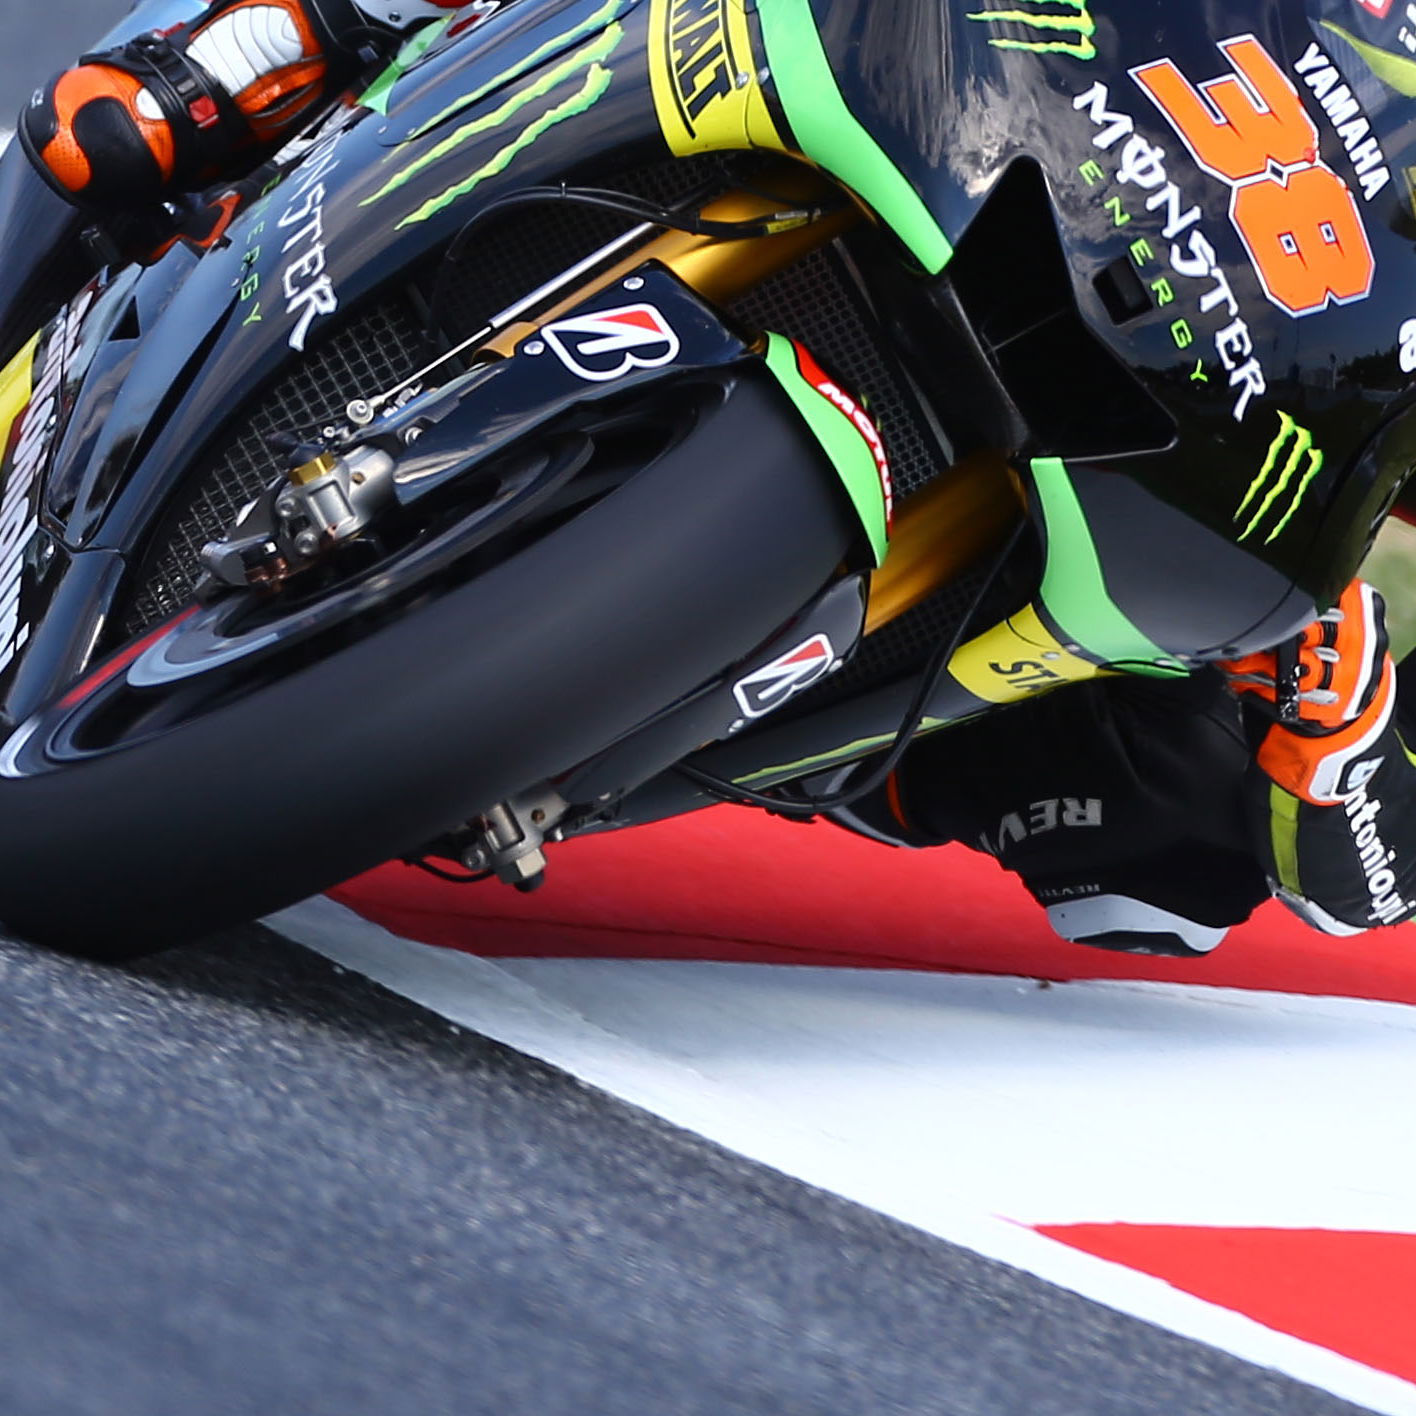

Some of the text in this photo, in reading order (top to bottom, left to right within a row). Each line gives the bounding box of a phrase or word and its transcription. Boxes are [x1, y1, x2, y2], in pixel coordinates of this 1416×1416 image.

[1127, 33, 1375, 318] 38
[1292, 42, 1394, 202] YAMAHA
[1073, 82, 1266, 422] MONSTER
[1079, 157, 1208, 383] ENERGY
